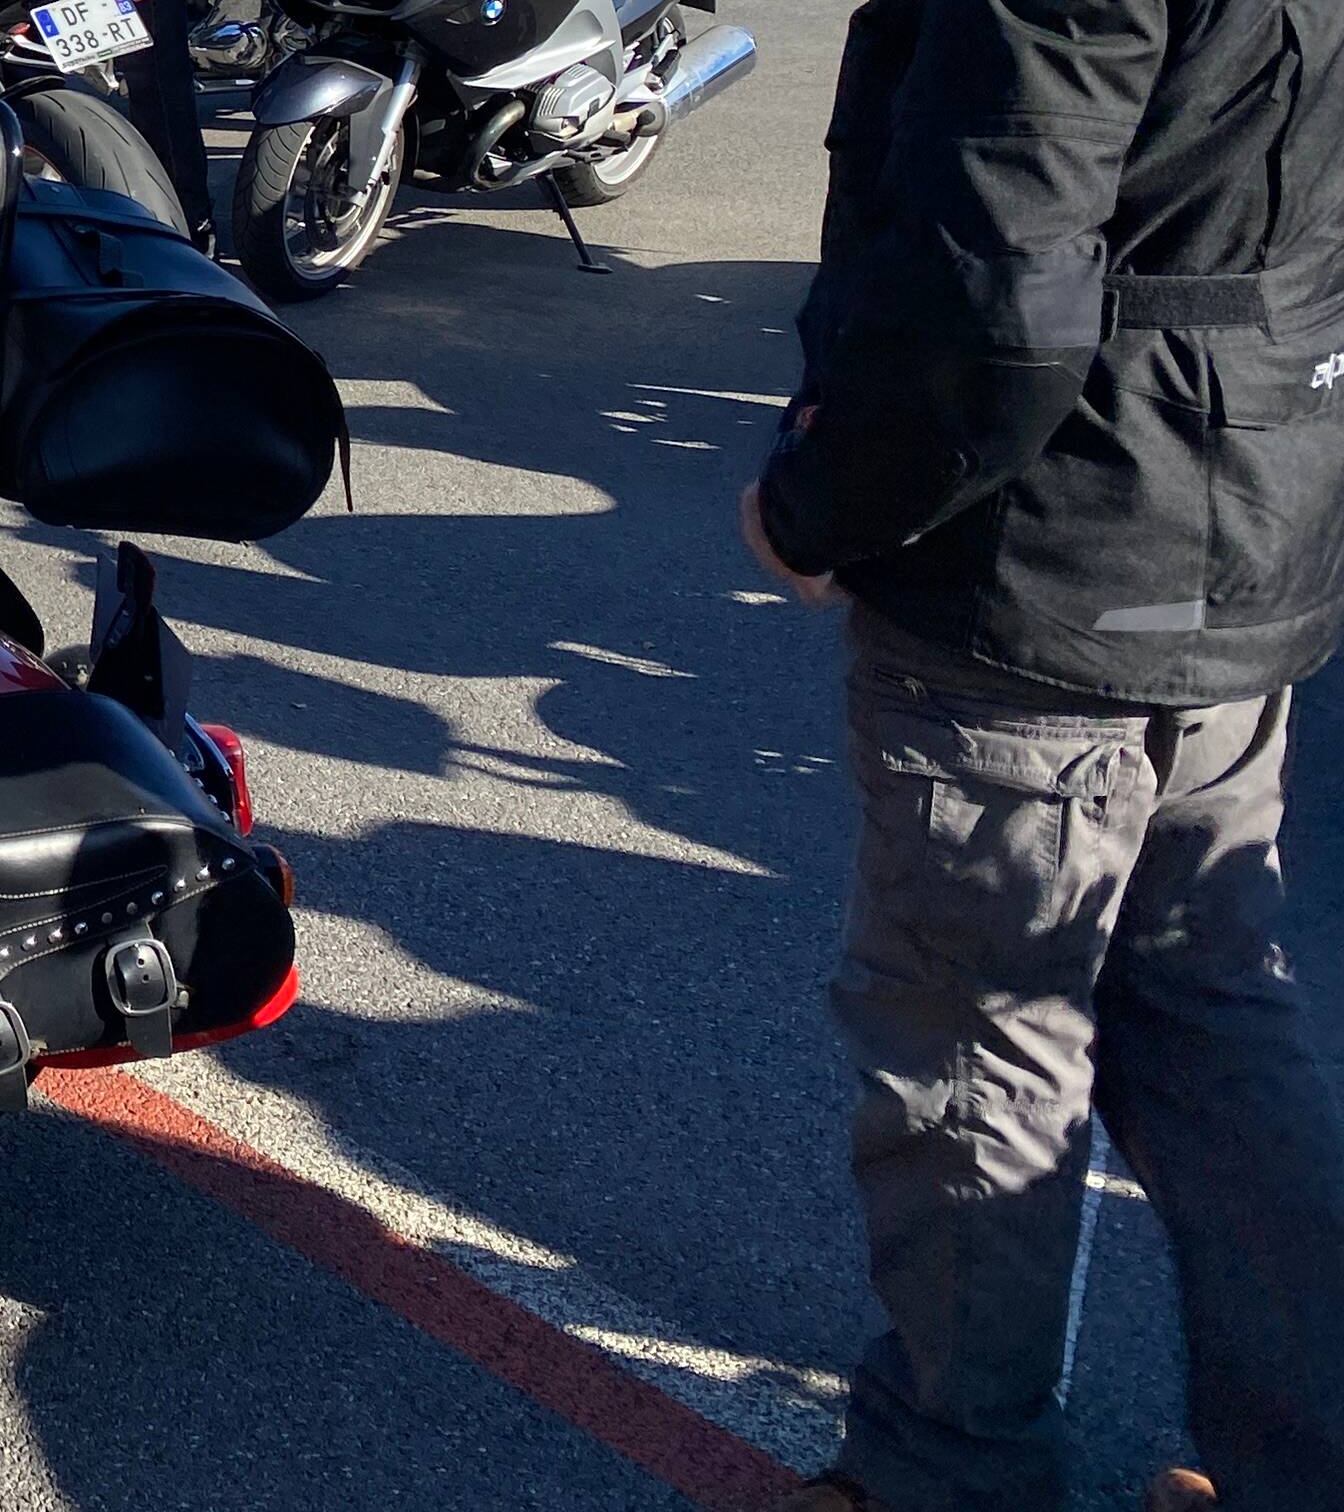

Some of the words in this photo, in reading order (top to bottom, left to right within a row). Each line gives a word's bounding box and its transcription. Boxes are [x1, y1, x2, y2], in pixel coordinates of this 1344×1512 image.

[60, 1, 89, 27] DF
[118, 0, 132, 13] 83
[55, 17, 136, 58] 338-RT
